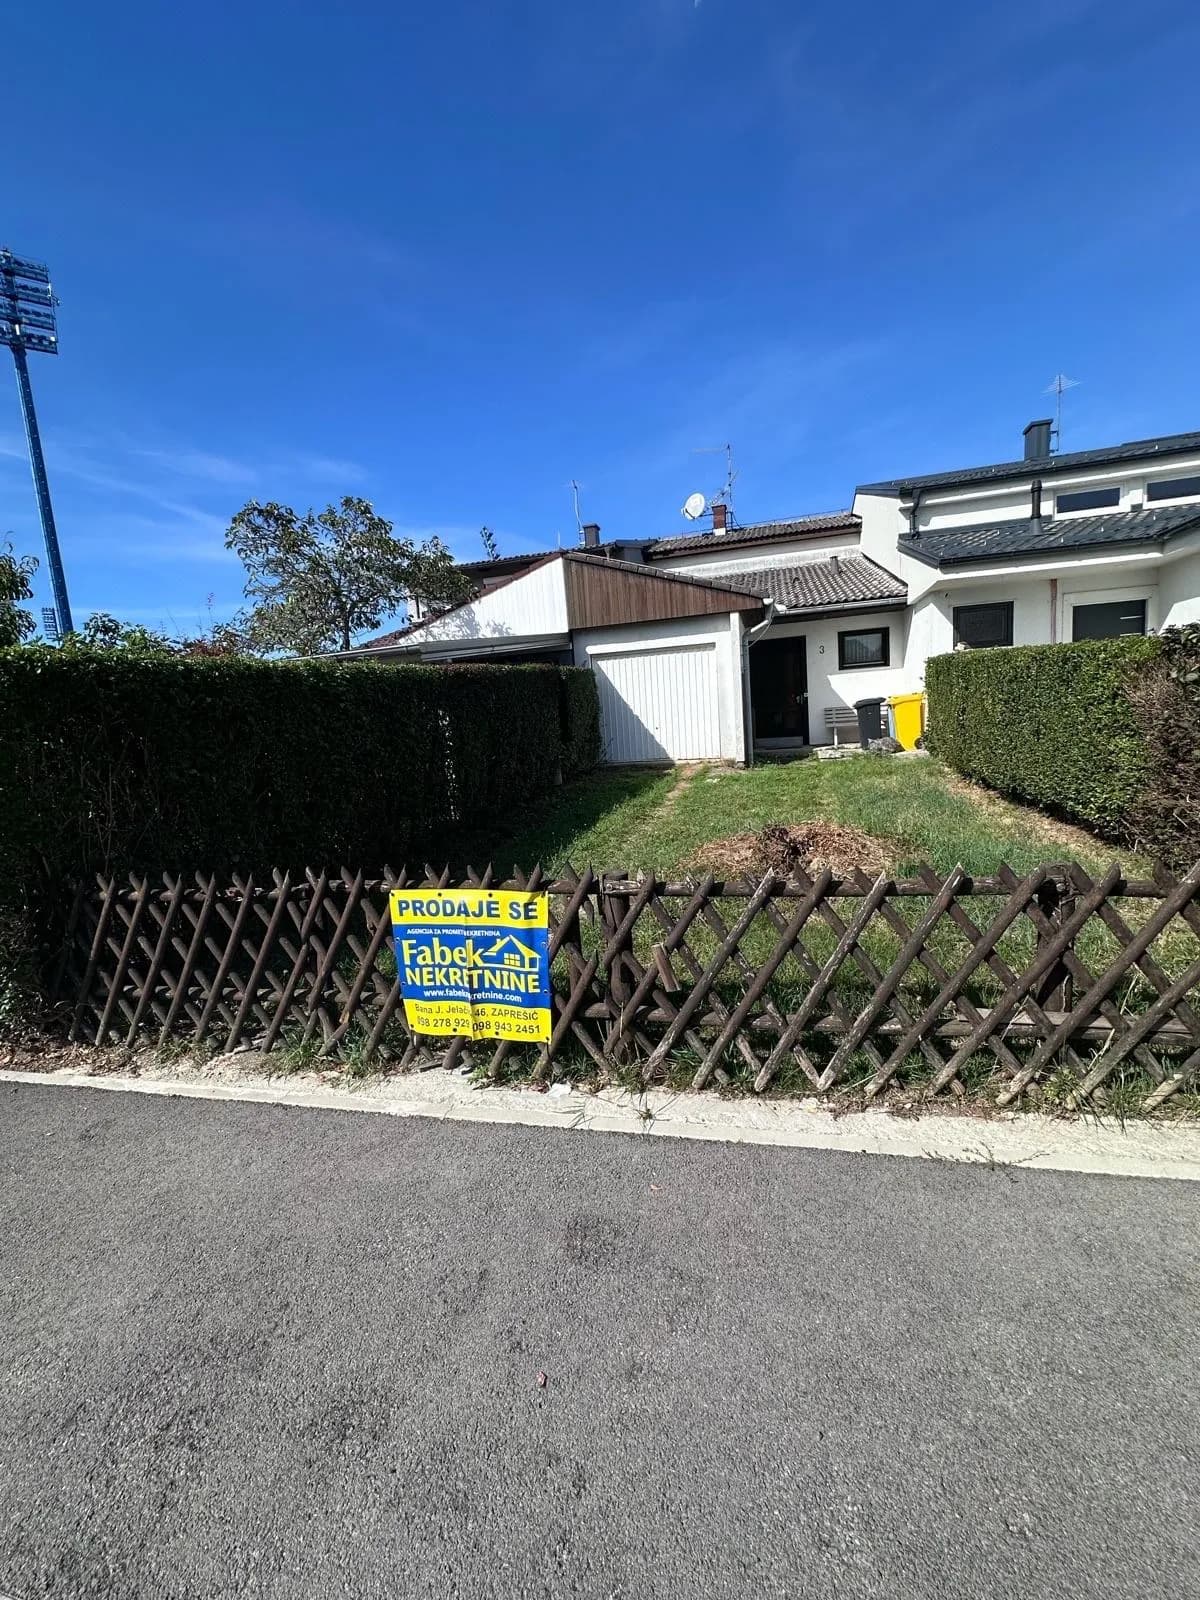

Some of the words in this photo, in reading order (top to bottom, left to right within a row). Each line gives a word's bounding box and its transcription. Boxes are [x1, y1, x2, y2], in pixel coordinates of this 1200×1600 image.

[819, 645, 825, 654] 3
[399, 899, 501, 918] PRODAJE
[509, 901, 538, 920] SE
[401, 937, 485, 968] Fabek
[405, 967, 541, 993] NEKRETNINE
[415, 1003, 433, 1014] Bana
[433, 1018, 451, 1028] 278
[472, 1021, 491, 1032] 098
[494, 1021, 512, 1032] 943
[515, 1024, 540, 1034] 2451
